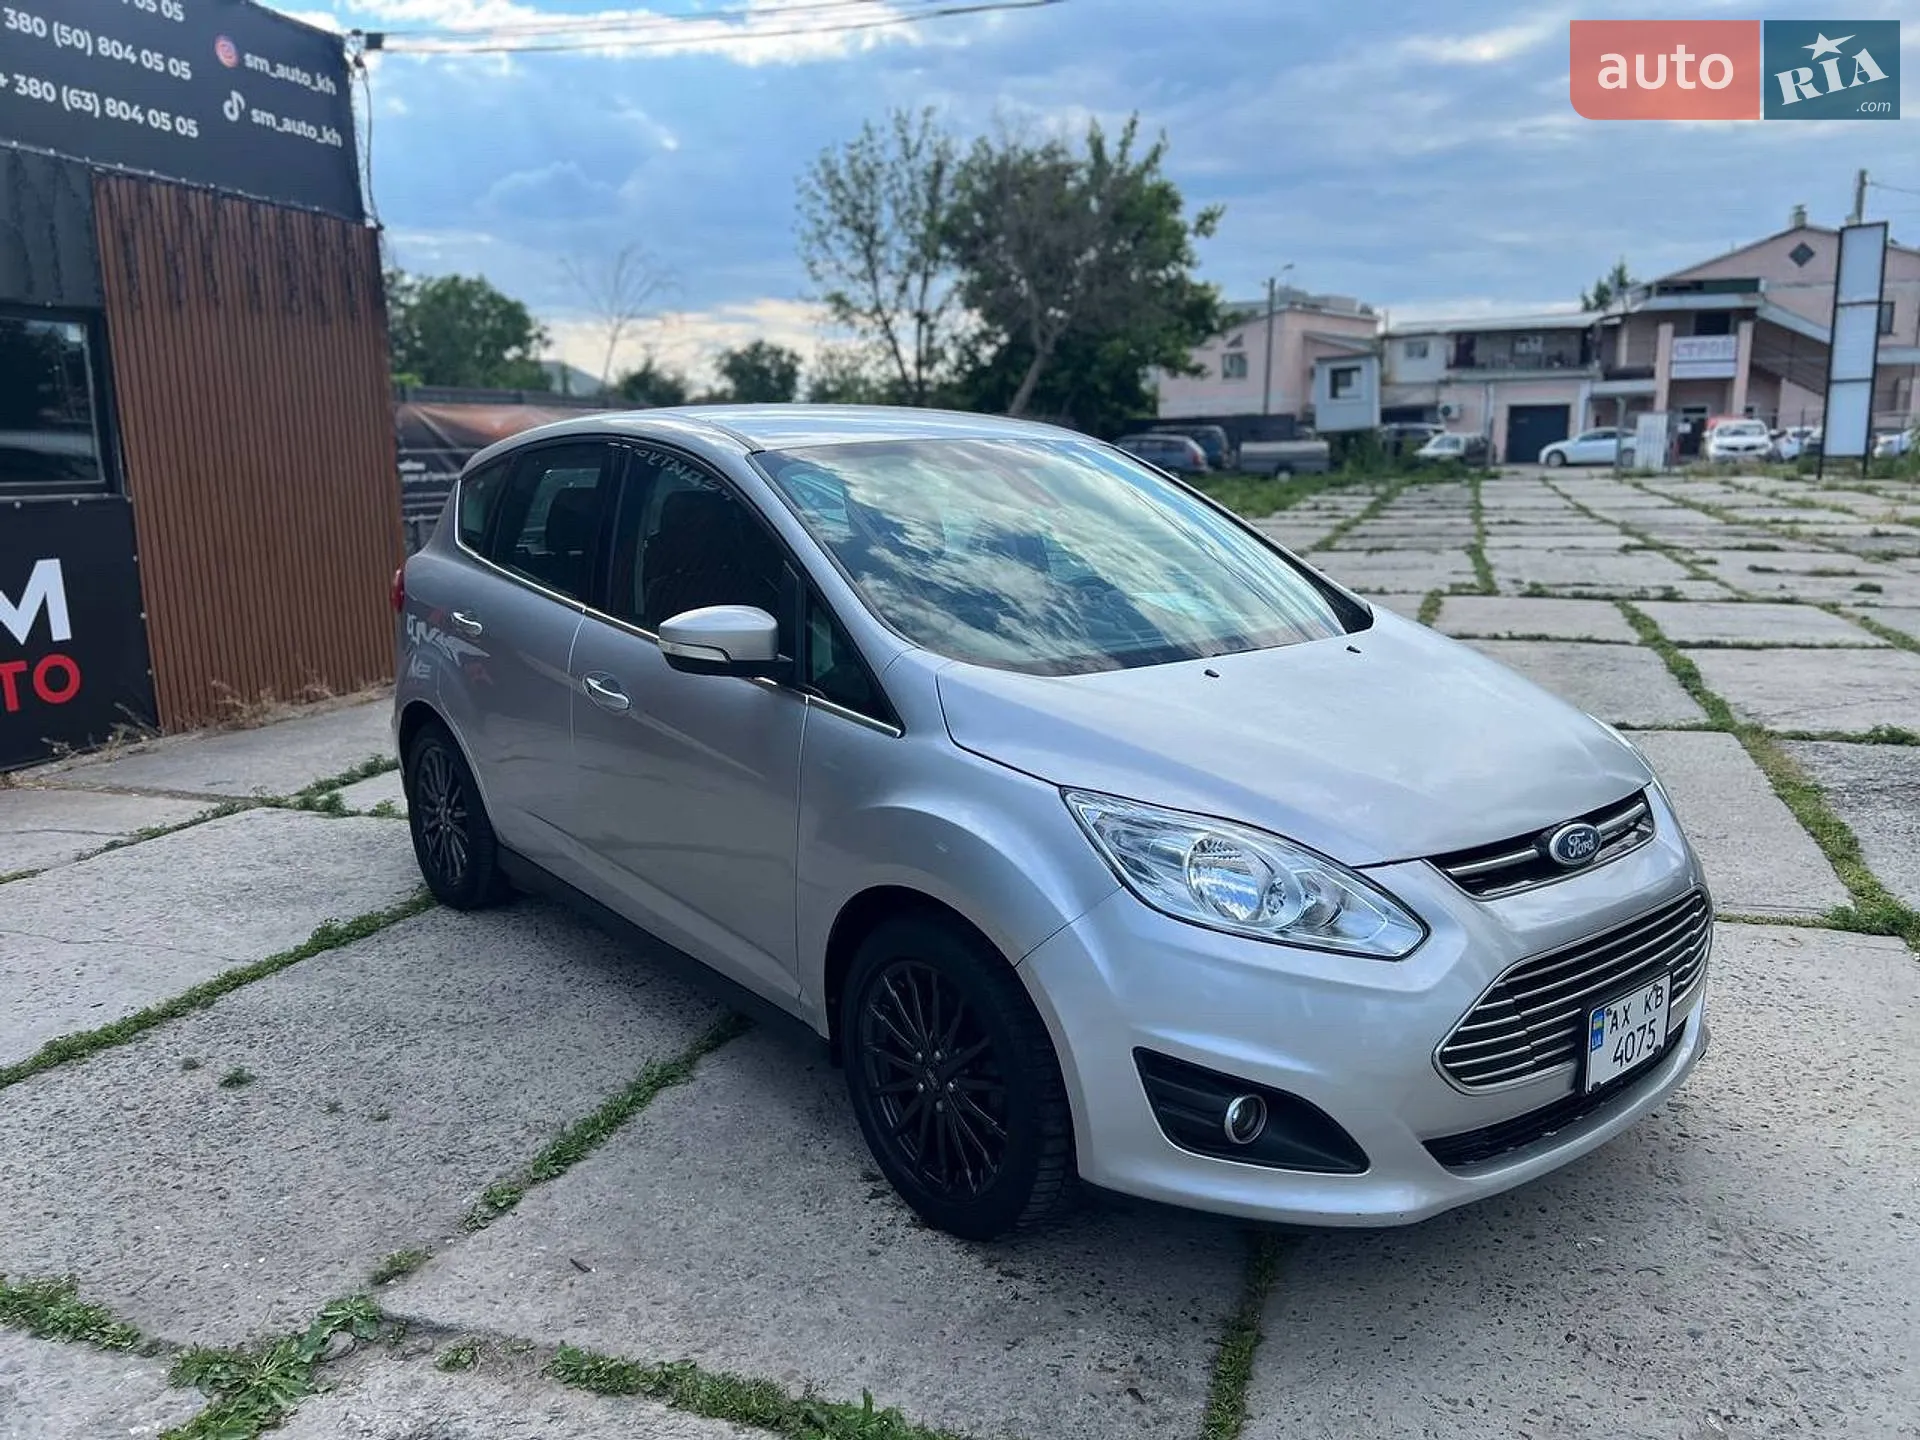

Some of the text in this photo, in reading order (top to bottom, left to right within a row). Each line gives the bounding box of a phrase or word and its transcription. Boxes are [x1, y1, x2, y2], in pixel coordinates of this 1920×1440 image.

[160, 0, 186, 23] 05
[3, 7, 193, 81] 380 (50) 804 05 05
[244, 53, 337, 96] sm_auto_kh
[13, 73, 57, 103] 380
[61, 85, 101, 119] (63)
[105, 97, 145, 125] 804
[147, 109, 173, 132] 05
[175, 116, 199, 139] 05
[251, 109, 342, 147] sm_auto_kh
[1567, 831, 1595, 857] Ford
[1609, 984, 1664, 1036] AX KB
[1612, 1018, 1658, 1068] 4075
